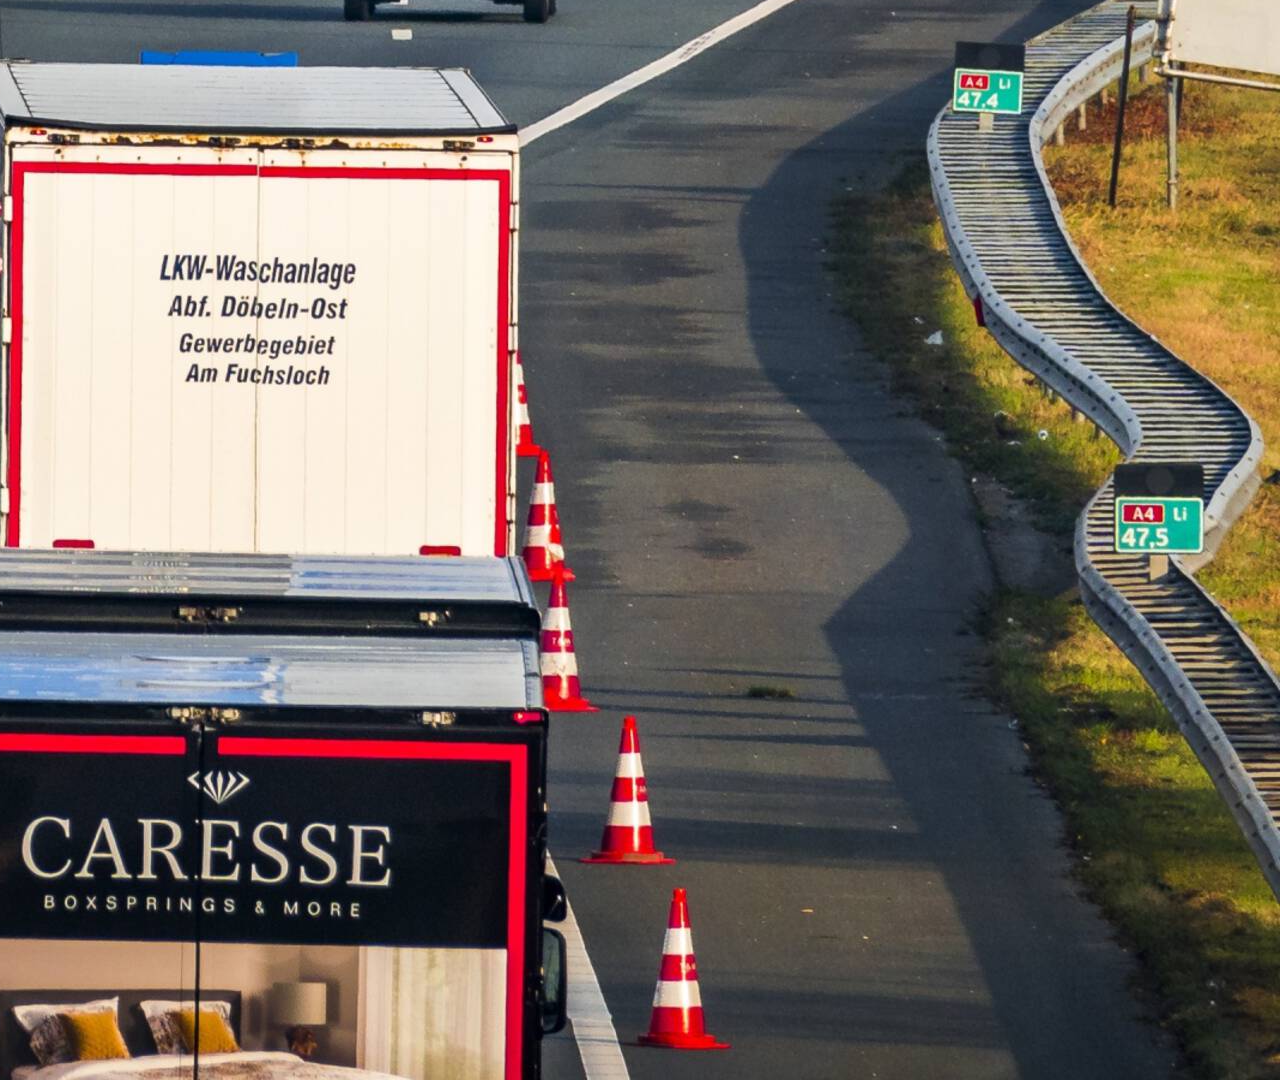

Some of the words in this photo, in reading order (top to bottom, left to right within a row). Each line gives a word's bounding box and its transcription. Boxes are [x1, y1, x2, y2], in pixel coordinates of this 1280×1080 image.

[965, 77, 984, 88] A4
[159, 254, 356, 290] LKW-Waschanlage
[168, 296, 211, 318] Abf.
[220, 295, 348, 320] Döbeln-Ost
[179, 333, 335, 359] Gewerbegebiet
[185, 364, 218, 383] Am
[225, 364, 330, 386] Fuchsloch
[1133, 506, 1154, 520] A4
[1173, 507, 1187, 521] Li
[22, 816, 392, 888] CARESSE
[44, 894, 236, 914] BOXSPRINGS
[255, 900, 265, 915] &
[285, 899, 361, 918] MORE
